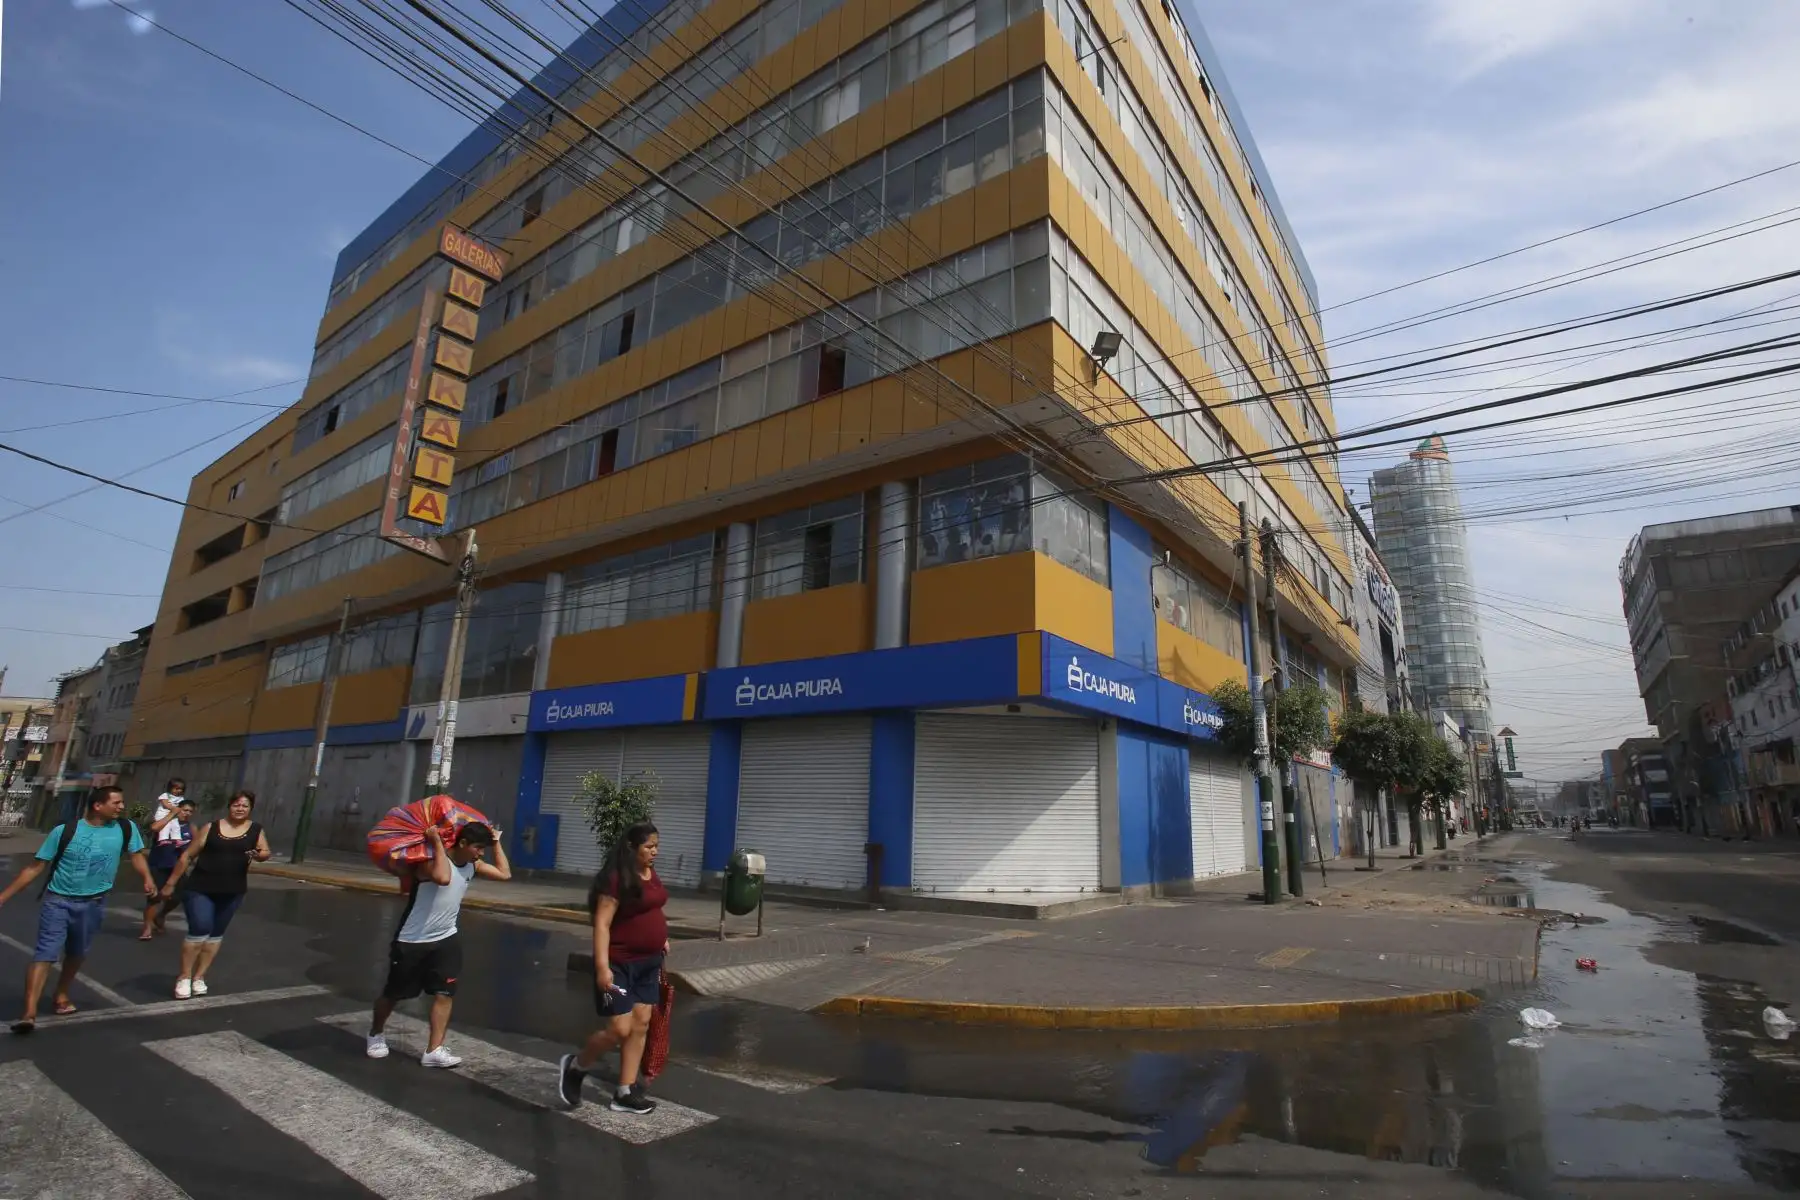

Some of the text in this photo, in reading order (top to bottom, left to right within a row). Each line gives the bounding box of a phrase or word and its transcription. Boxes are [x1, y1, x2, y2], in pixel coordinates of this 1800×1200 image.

[445, 233, 502, 277] GALERIAS
[411, 274, 481, 521] MARKATA
[389, 378, 419, 499] UNANUE
[757, 678, 842, 700] CAJA PIURA
[1084, 672, 1136, 704] CAJA PIURA
[560, 701, 613, 718] CAJA PIURA
[1193, 709, 1208, 725] CAJA
